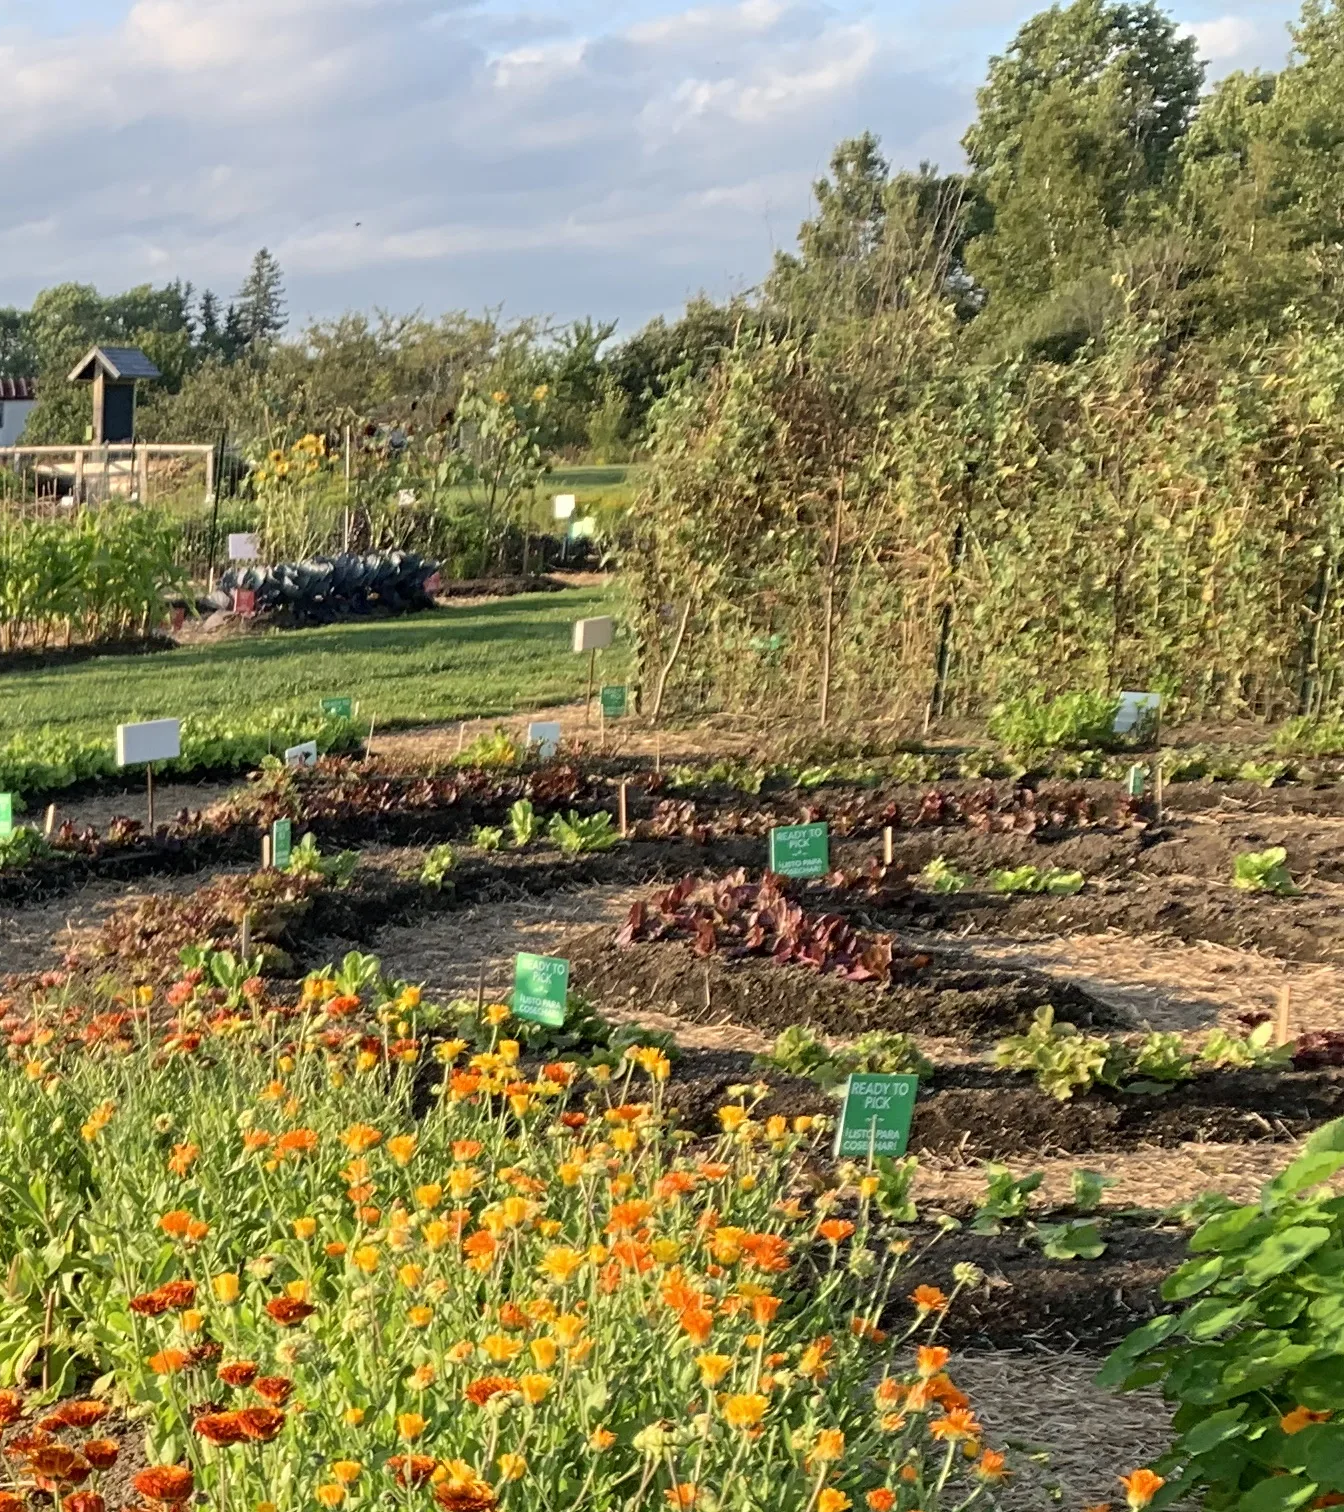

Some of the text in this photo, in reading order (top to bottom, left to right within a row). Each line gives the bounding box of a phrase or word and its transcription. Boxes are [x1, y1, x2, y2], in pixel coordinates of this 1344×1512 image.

[851, 1081, 910, 1096] READY TO
[864, 1096, 892, 1109] PICK
[875, 1129, 900, 1139] PARA
